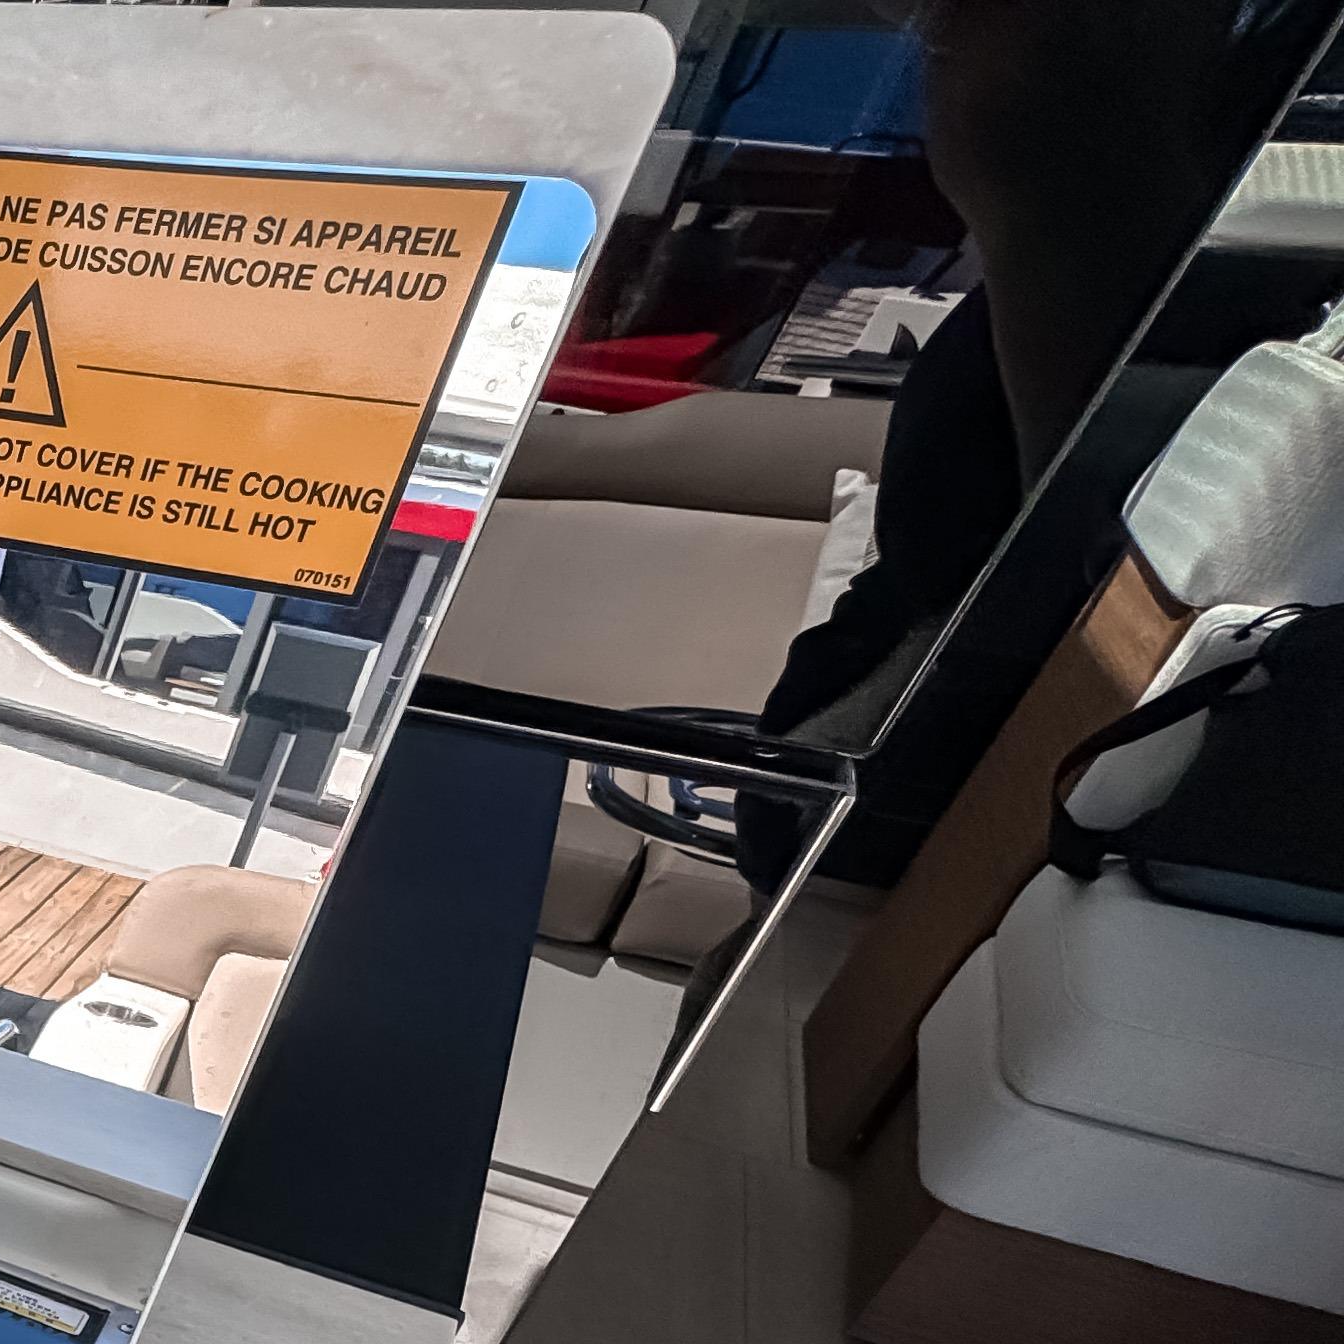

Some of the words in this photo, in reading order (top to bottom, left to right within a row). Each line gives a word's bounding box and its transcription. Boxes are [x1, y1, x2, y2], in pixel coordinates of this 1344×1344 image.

[0, 196, 38, 225] NE
[47, 200, 106, 232] PAS
[115, 206, 244, 244] FERMER
[253, 215, 285, 246] SI
[292, 219, 462, 259] APPAREIL
[39, 241, 172, 280] CUISSON
[181, 253, 316, 292] ENCORE
[324, 265, 448, 302] CHAUD
[36, 442, 135, 480] COVER
[141, 456, 169, 483] IF
[176, 461, 230, 494] THE
[238, 471, 387, 515] COOKING
[128, 493, 154, 520] IS
[161, 498, 240, 533] STILL
[249, 512, 316, 543] HOT
[294, 568, 352, 591] 070151
